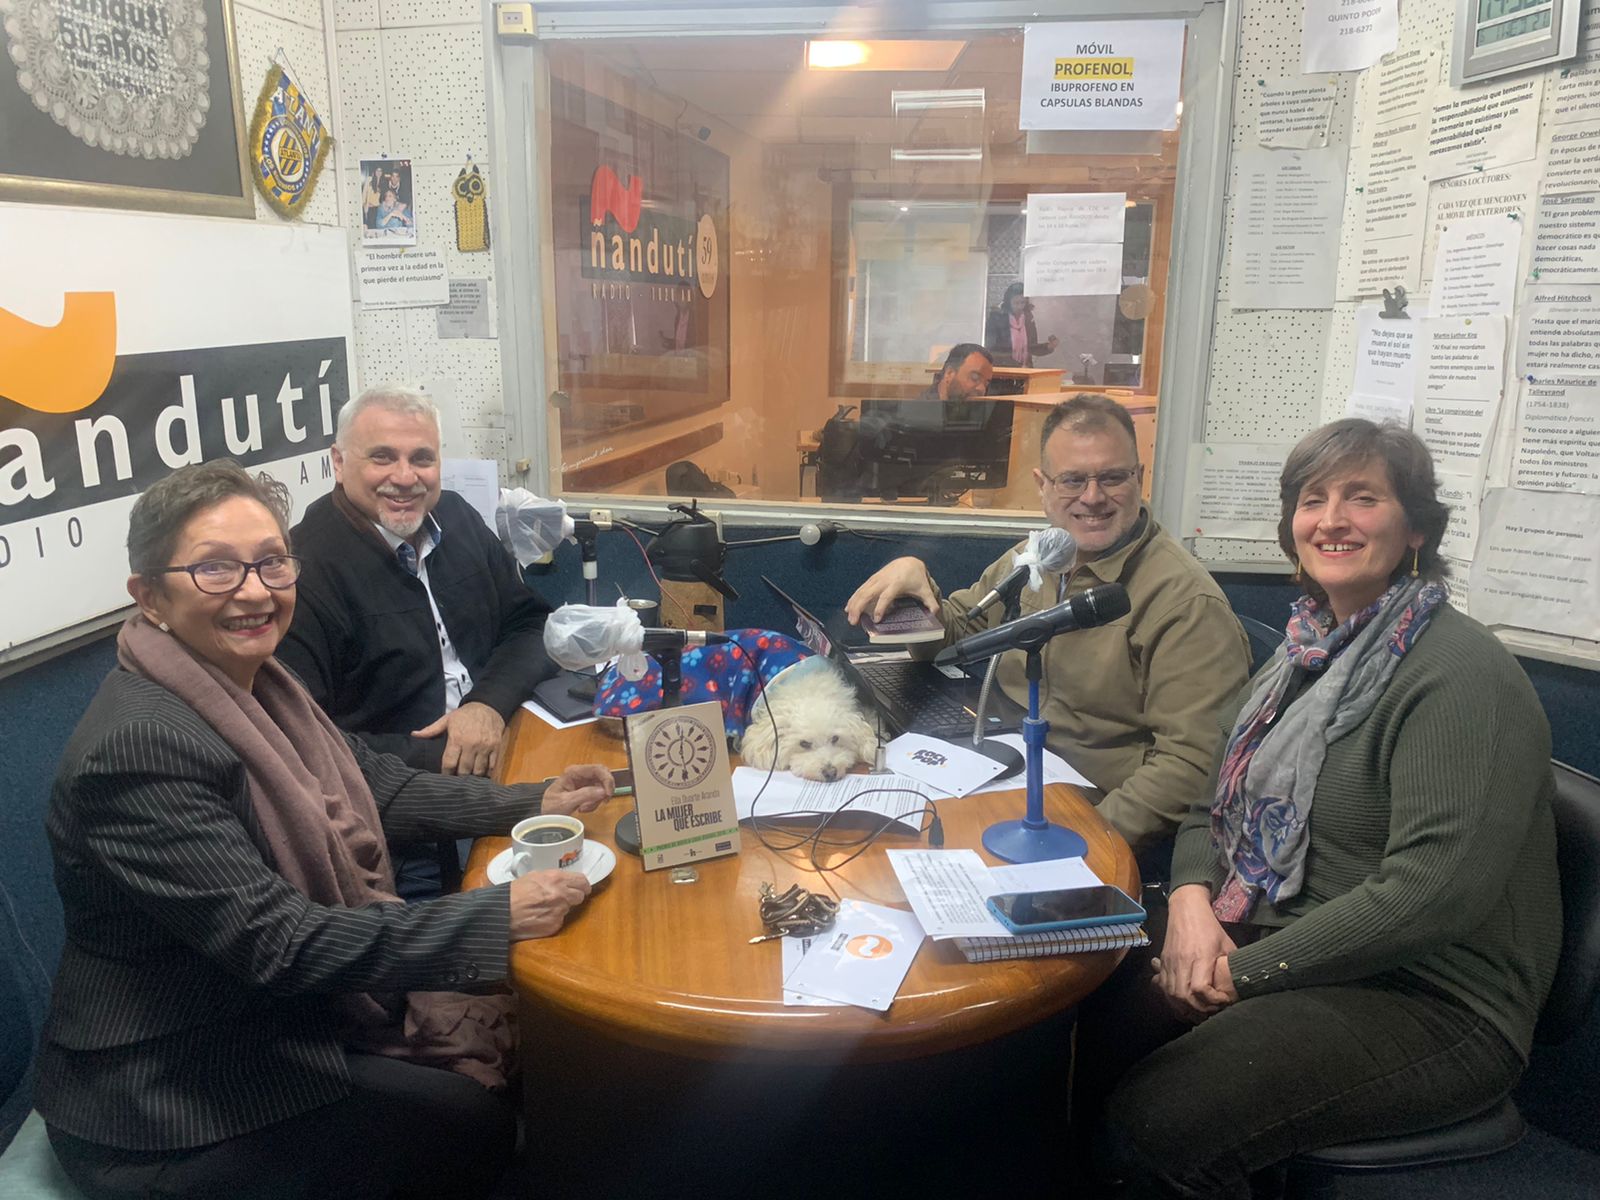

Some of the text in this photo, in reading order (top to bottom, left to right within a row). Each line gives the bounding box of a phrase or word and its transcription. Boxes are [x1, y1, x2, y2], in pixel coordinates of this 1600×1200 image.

[1328, 12, 1359, 22] QUINTO
[1076, 42, 1114, 55] MÓVIL
[1055, 62, 1133, 77] PROFENOL,
[1051, 83, 1134, 92] IBUPROFENO EN
[1559, 83, 1576, 91] carta
[1461, 94, 1488, 106] memoria
[1490, 91, 1501, 99] que
[1502, 83, 1528, 95] tenemos
[1529, 81, 1534, 89] y
[1041, 98, 1143, 108] CAPSULAS BLANDAS
[1487, 102, 1499, 110] que
[1439, 121, 1464, 133] memoria
[1509, 107, 1518, 115] sin
[1561, 146, 1586, 154] épocas
[1547, 169, 1581, 177] convierte
[1438, 193, 1527, 210] CADA VEZ QUE MENCIONEN
[1552, 211, 1569, 219] gran
[591, 217, 694, 278] ñandutí
[1557, 294, 1592, 302] Hitchcock
[1528, 388, 1565, 396] Talleyrand
[1525, 414, 1567, 422] Diplomático
[1554, 460, 1588, 468] ministros
[1518, 469, 1553, 477] presentes
[1524, 527, 1545, 535] grupos
[1556, 531, 1584, 539] personas
[912, 749, 948, 766] ROCK
[655, 803, 694, 822] LA MUJER
[673, 810, 723, 832] QUE ESCRIBE
